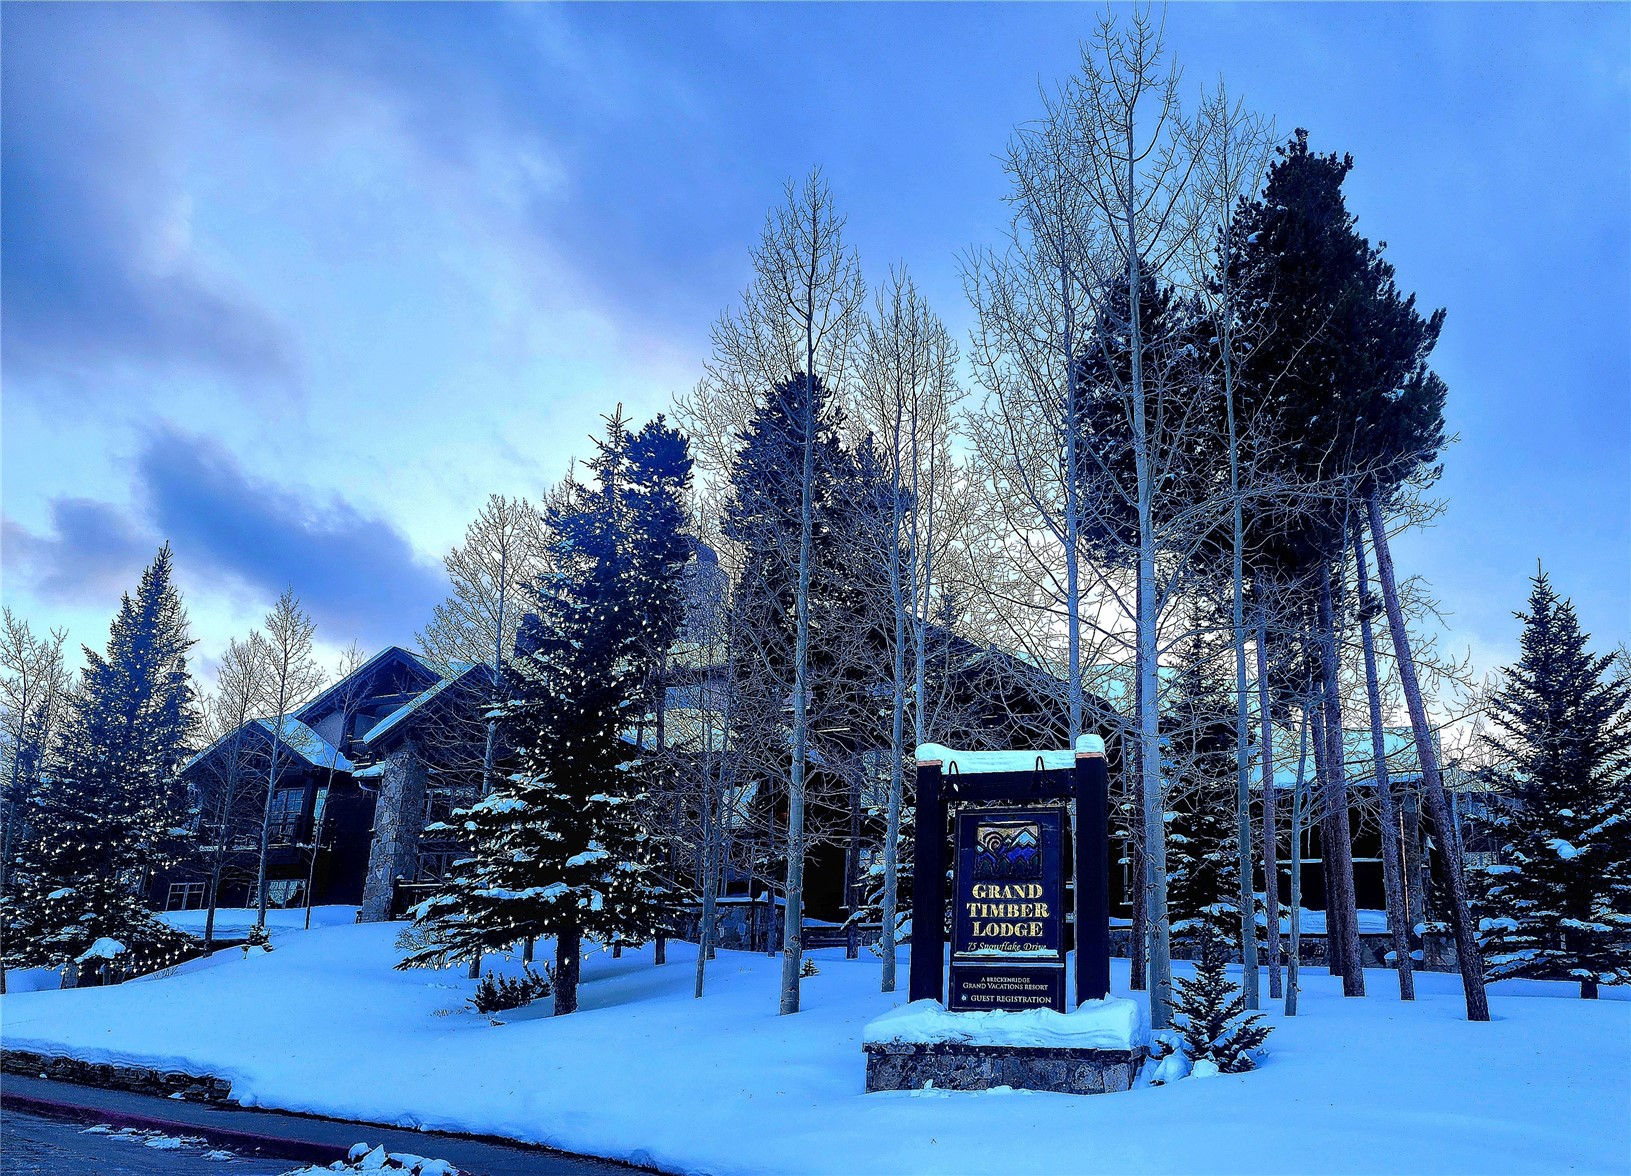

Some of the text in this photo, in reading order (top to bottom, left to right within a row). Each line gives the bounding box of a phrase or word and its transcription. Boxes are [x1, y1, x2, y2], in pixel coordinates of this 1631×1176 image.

[972, 883, 1043, 899] GRAND
[966, 902, 1050, 918] TIMBER
[972, 921, 1043, 937] LODGE
[967, 941, 1047, 952] 75 Snowflake Drive
[987, 982, 1024, 990] VACATIONS
[970, 994, 1052, 1003] GUEST REGISTRATION
